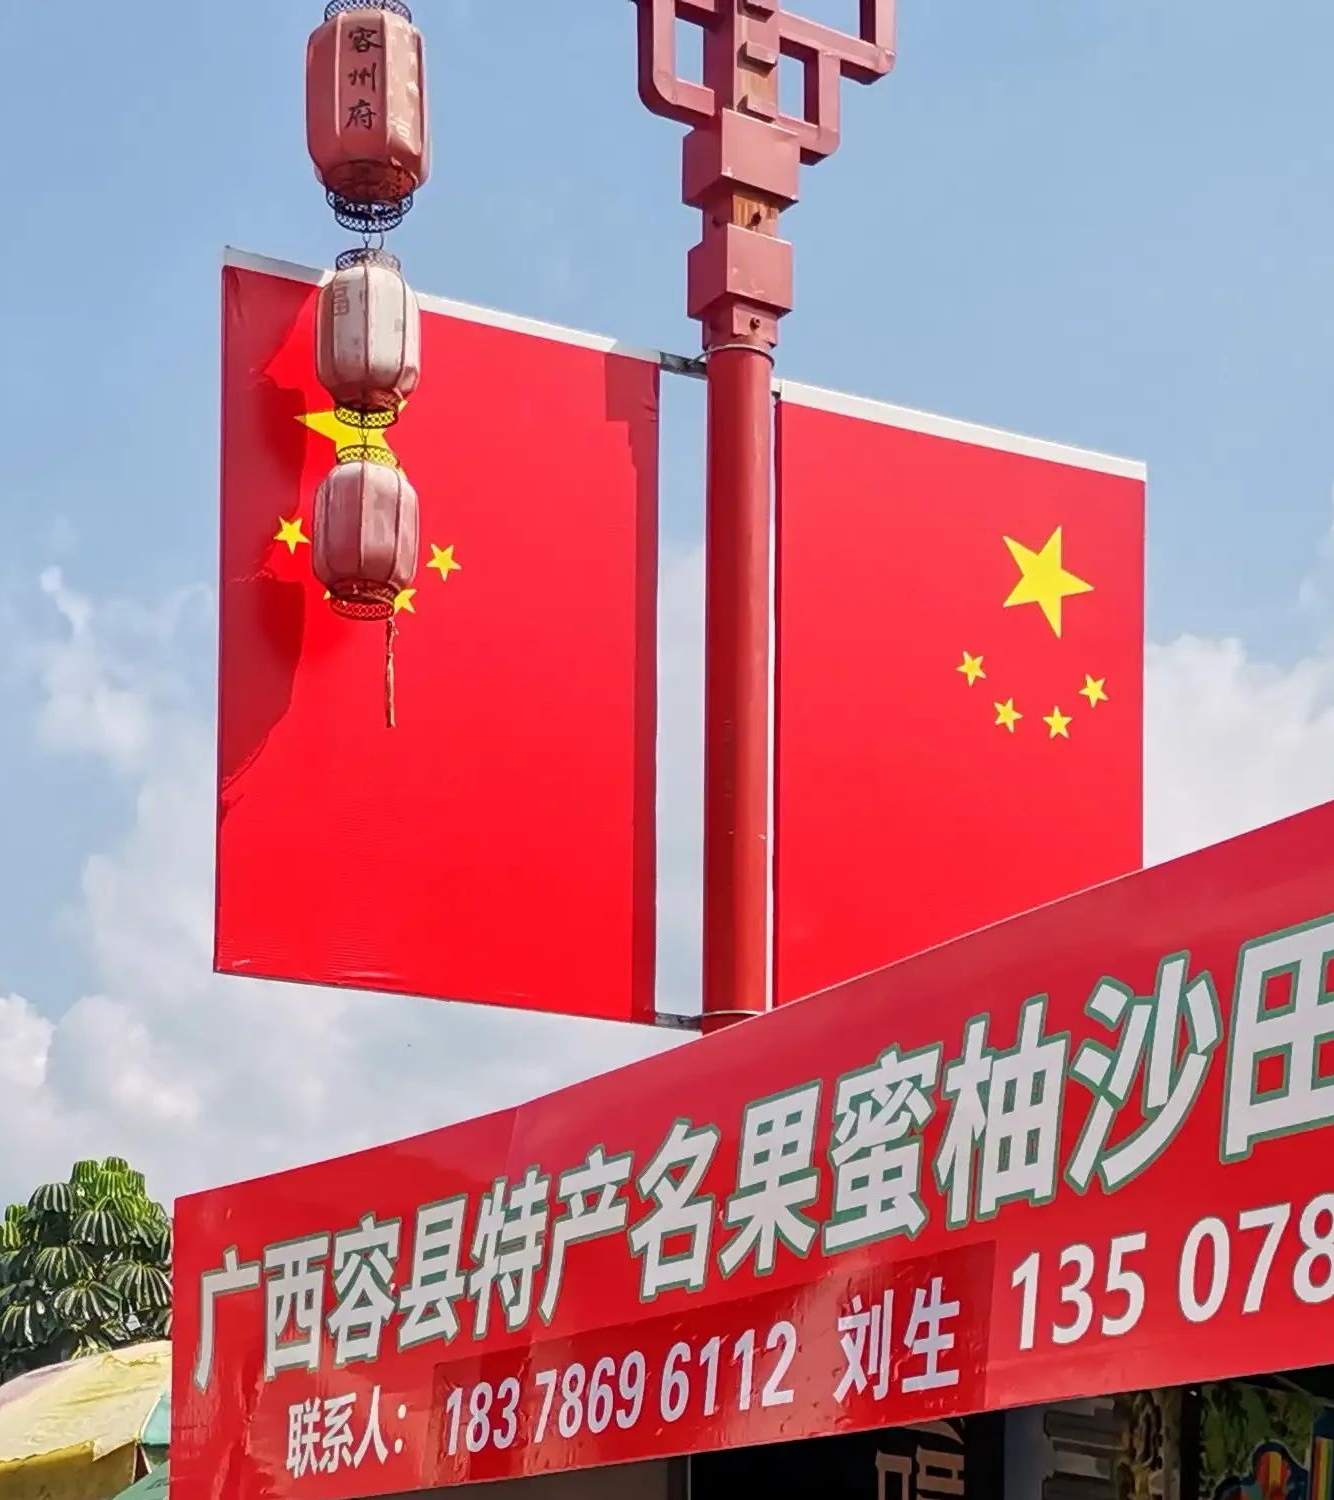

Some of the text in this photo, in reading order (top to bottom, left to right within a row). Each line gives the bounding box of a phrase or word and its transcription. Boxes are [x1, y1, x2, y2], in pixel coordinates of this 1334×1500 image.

[344, 26, 383, 131] 容州府
[445, 1378, 518, 1456] 183
[534, 1350, 646, 1445] 7869
[660, 1320, 797, 1423] 6112
[833, 1277, 962, 1404] 刘生
[1011, 1232, 1147, 1352] 135
